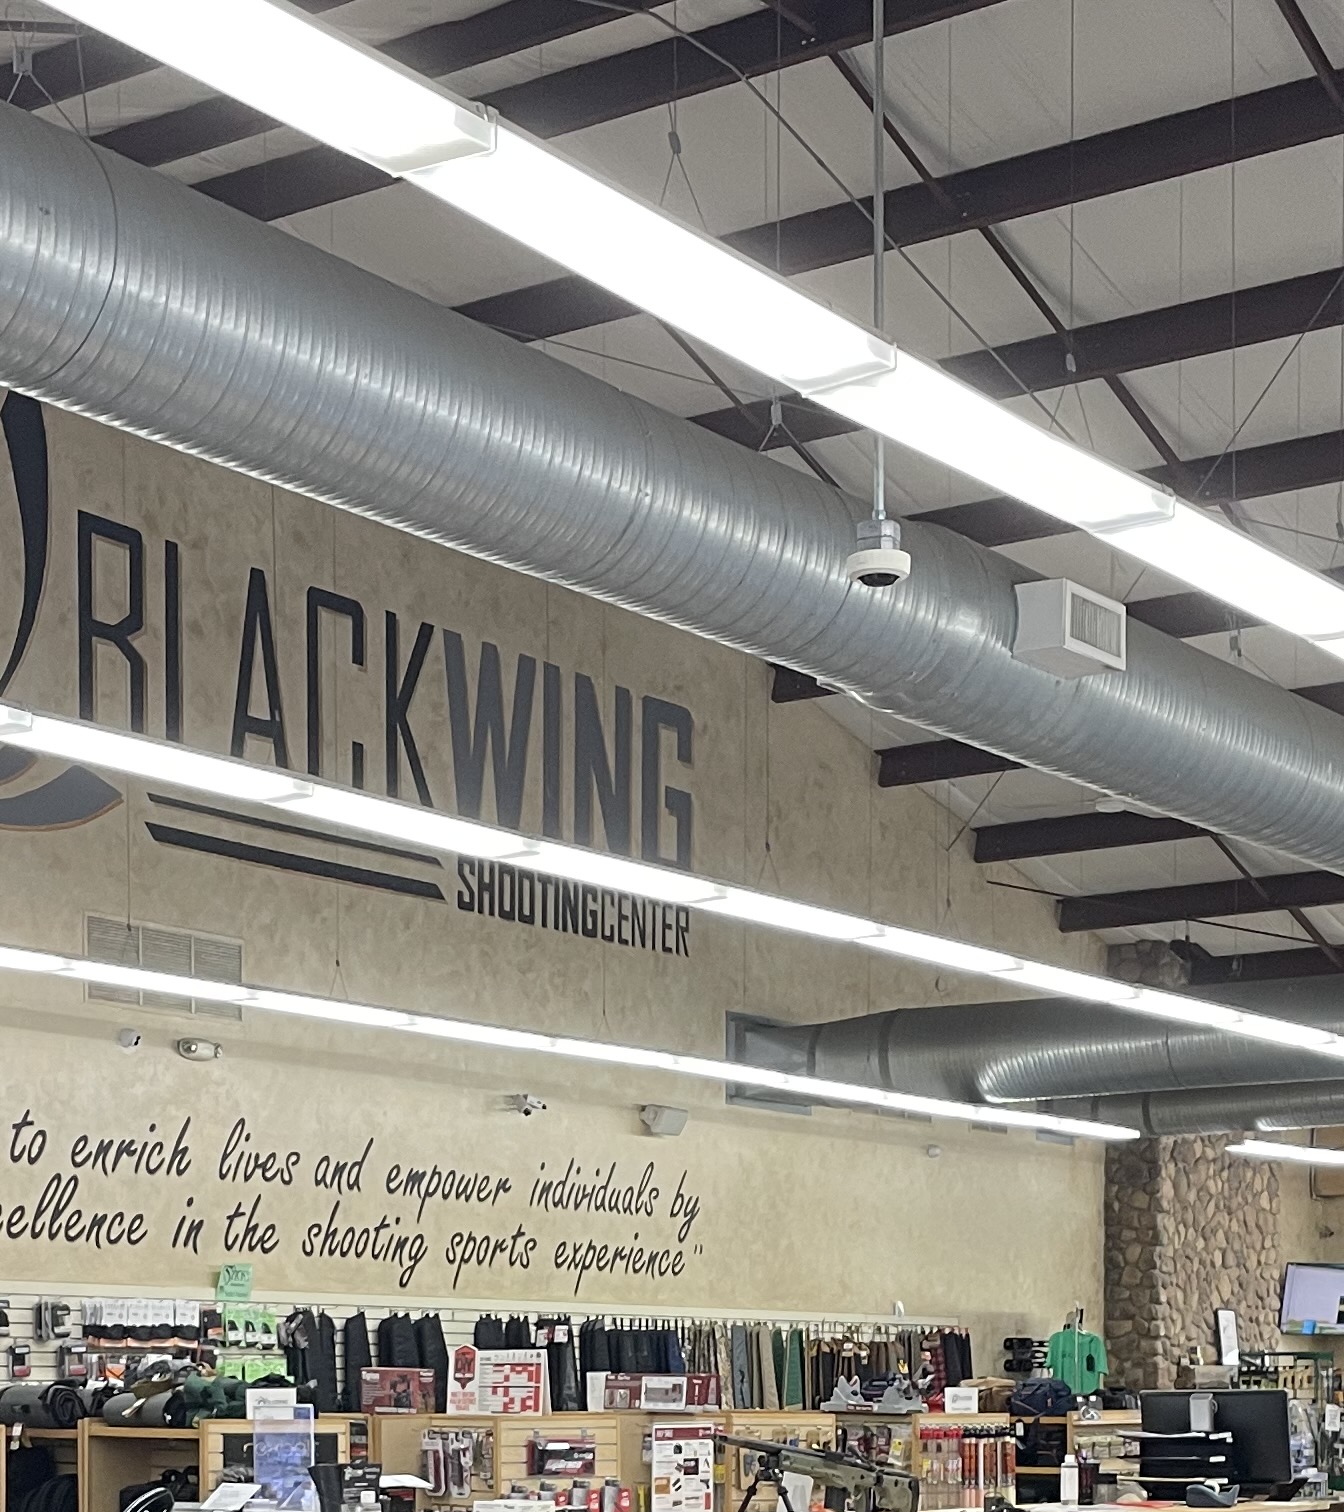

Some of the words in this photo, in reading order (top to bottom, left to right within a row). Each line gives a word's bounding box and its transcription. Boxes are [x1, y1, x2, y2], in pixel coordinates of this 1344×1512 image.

[10, 1109, 47, 1168] to
[71, 1116, 193, 1178] enrich
[219, 1117, 301, 1185] lives
[314, 1137, 374, 1193] and
[386, 1161, 513, 1222] empower
[530, 1158, 660, 1219] individuals
[670, 1170, 701, 1242] by
[172, 1197, 205, 1254] in
[224, 1194, 279, 1255] the
[302, 1200, 429, 1289] shooting
[446, 1224, 538, 1290] sports
